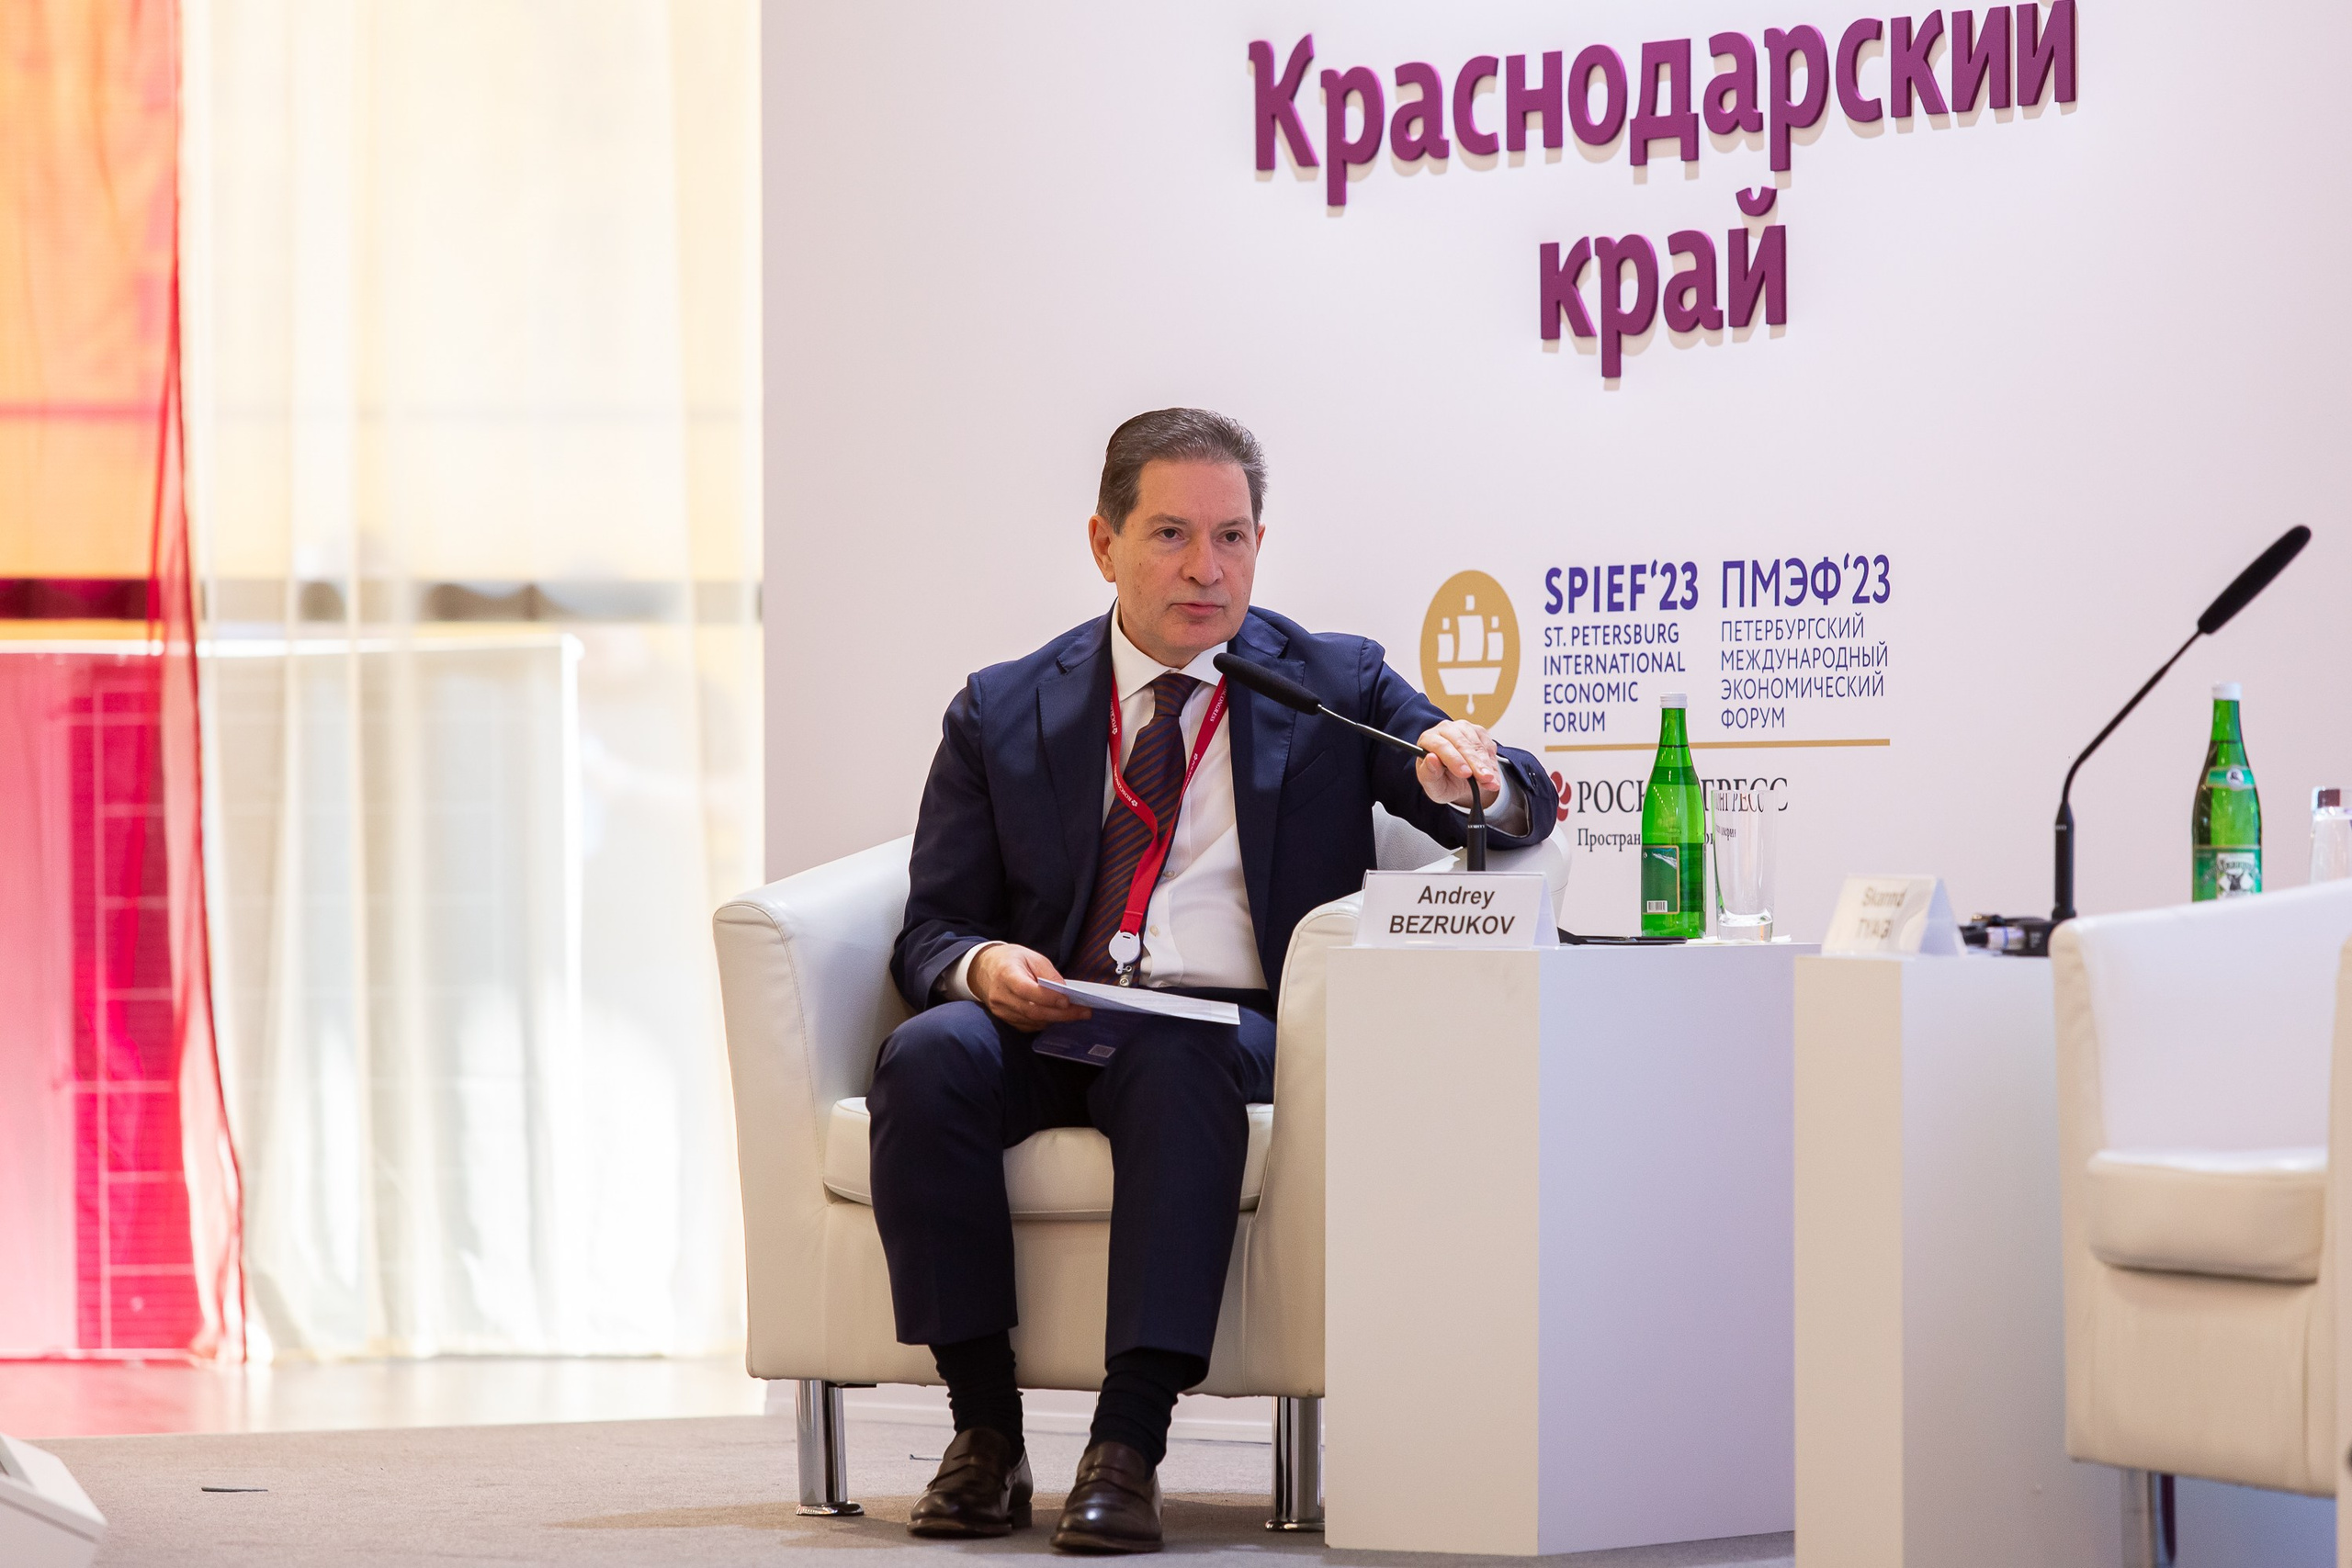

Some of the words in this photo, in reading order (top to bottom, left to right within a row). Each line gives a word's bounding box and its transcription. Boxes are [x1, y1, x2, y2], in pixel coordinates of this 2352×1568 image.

[1540, 186, 1787, 378] край
[1544, 626, 1566, 648] ST.
[1571, 622, 1679, 647] PETERSBURG
[1721, 611, 1864, 642] ПЕТЕРБУРГСКИЙ
[1544, 650, 1686, 676] INTERNATIONAL
[1721, 640, 1888, 674] МЕЖДУНАРОДНЫЙ
[1544, 681, 1639, 705] ECONOMIC
[1721, 670, 1883, 701] ЭКОНОМИЧЕСКИЙ
[1544, 710, 1605, 733] FORUM
[1721, 706, 1785, 729] ФОРУМ
[1417, 886, 1496, 909] Andrey
[1389, 915, 1516, 935] BEZRUKOV
